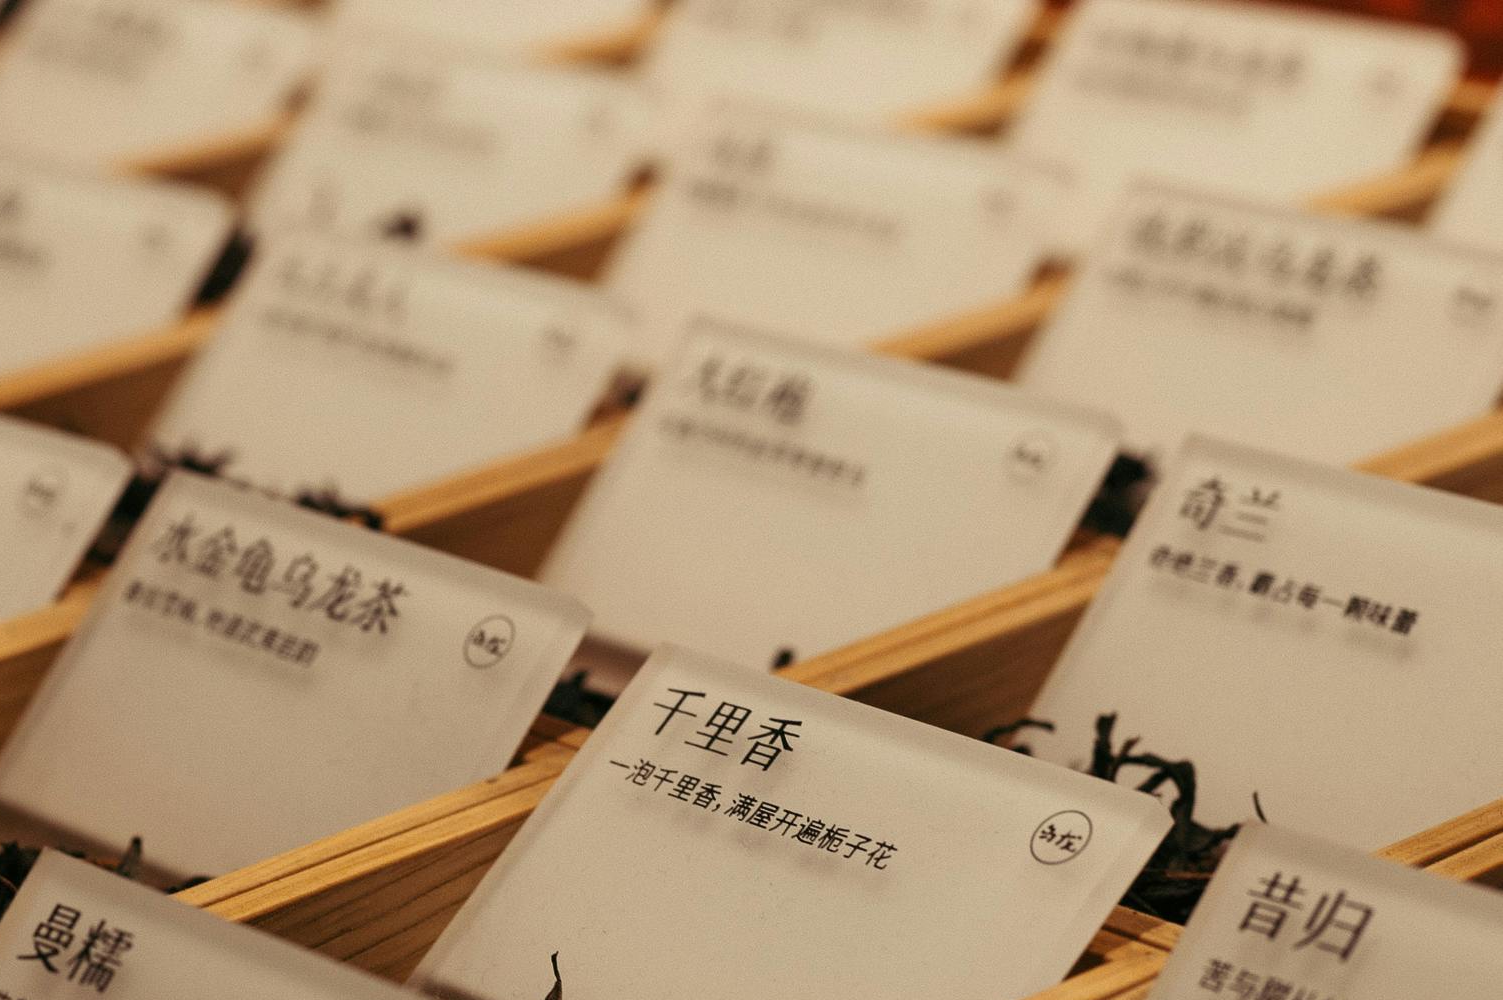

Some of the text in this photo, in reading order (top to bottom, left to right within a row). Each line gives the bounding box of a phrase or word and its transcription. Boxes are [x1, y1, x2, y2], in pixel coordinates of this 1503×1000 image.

[1179, 476, 1281, 543] 奇兰
[154, 514, 407, 634] 水金龟乌龙茶
[653, 687, 803, 771] 千里香
[609, 758, 898, 871] 一泡千里香，满屋开遍栀子花
[17, 903, 135, 995] 曼糯
[1237, 871, 1375, 963] 昔归
